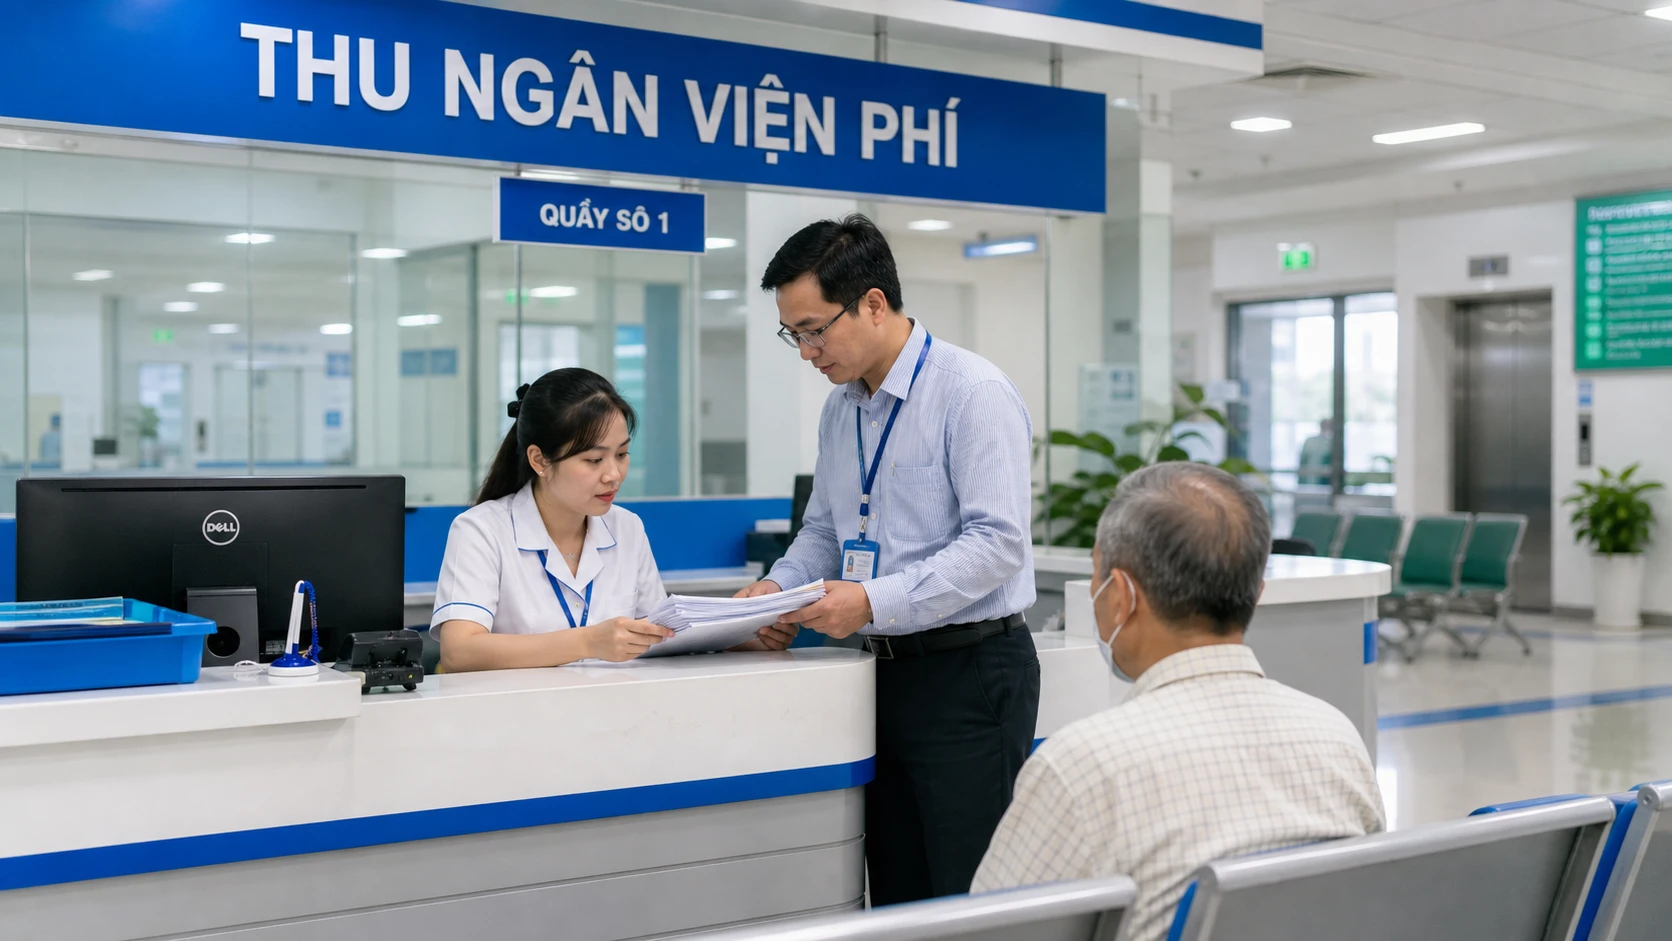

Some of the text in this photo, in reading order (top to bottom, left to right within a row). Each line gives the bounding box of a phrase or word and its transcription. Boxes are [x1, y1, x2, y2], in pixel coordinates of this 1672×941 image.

[240, 22, 961, 169] THU NGÂN VIỆN PHÍ
[658, 211, 669, 234] 1
[206, 522, 237, 533] DELL
